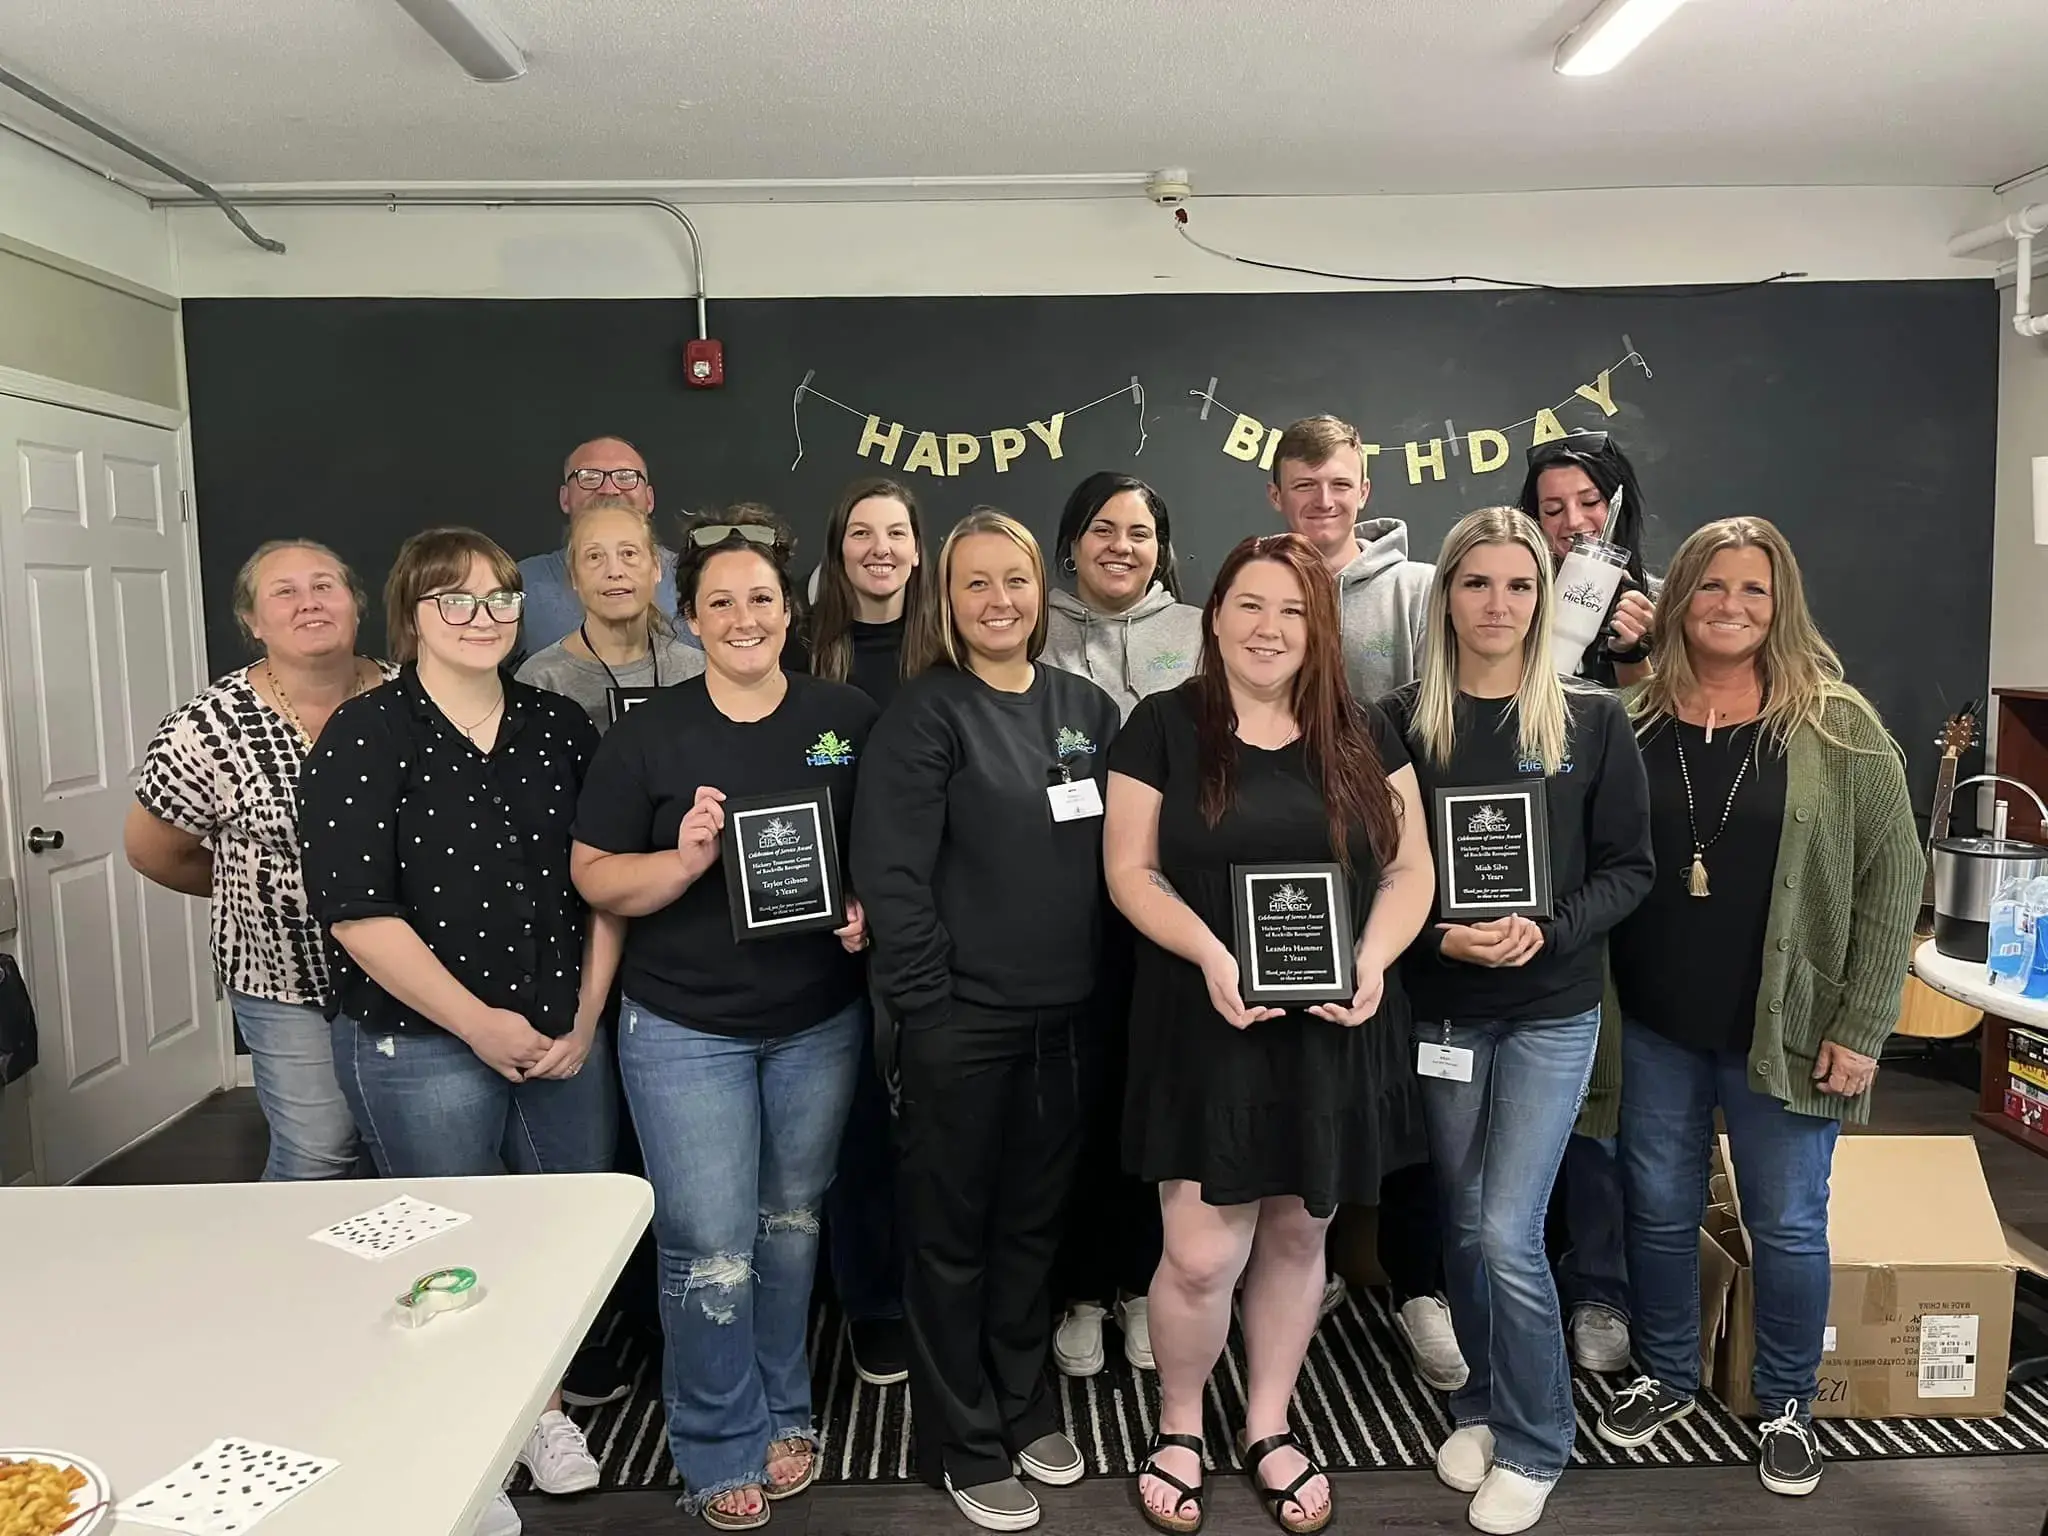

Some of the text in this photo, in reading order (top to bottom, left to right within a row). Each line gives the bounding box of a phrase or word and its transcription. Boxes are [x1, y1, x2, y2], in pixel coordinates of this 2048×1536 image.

[1222, 368, 1618, 484] BIHDAY
[857, 412, 1064, 476] HAPPY
[1562, 591, 1602, 613] Hickory
[1518, 759, 1574, 773] Hicry
[1468, 823, 1510, 833] Hickory
[759, 835, 800, 848] Hickory
[797, 844, 813, 852] Award
[752, 860, 772, 869] Hickory
[762, 877, 808, 889] Taylor Gibson
[1269, 902, 1312, 912] Hickory
[1265, 945, 1292, 953] Leandra
[1877, 1358, 1905, 1366] COATED
